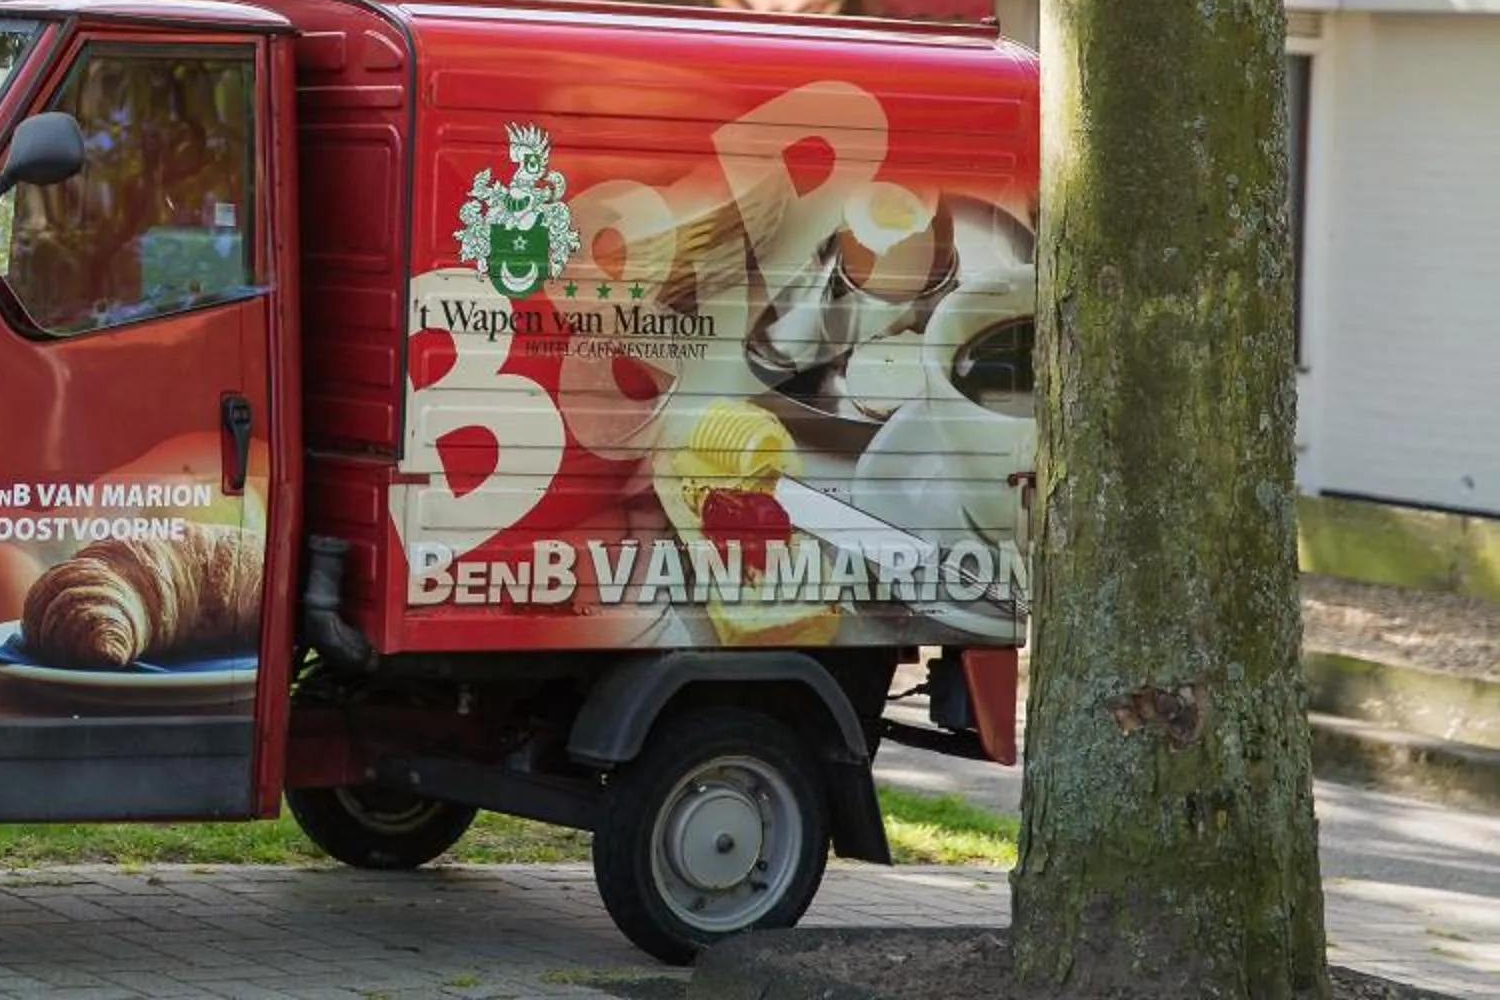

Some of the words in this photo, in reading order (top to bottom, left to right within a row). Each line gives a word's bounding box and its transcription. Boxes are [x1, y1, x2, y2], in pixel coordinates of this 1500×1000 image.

[440, 300, 543, 341] Wapen
[552, 312, 603, 333] van
[614, 303, 716, 337] Marion
[37, 483, 96, 507] VAN
[102, 484, 212, 507] MARION
[587, 540, 743, 603] VAN
[760, 539, 1031, 601] MARION
